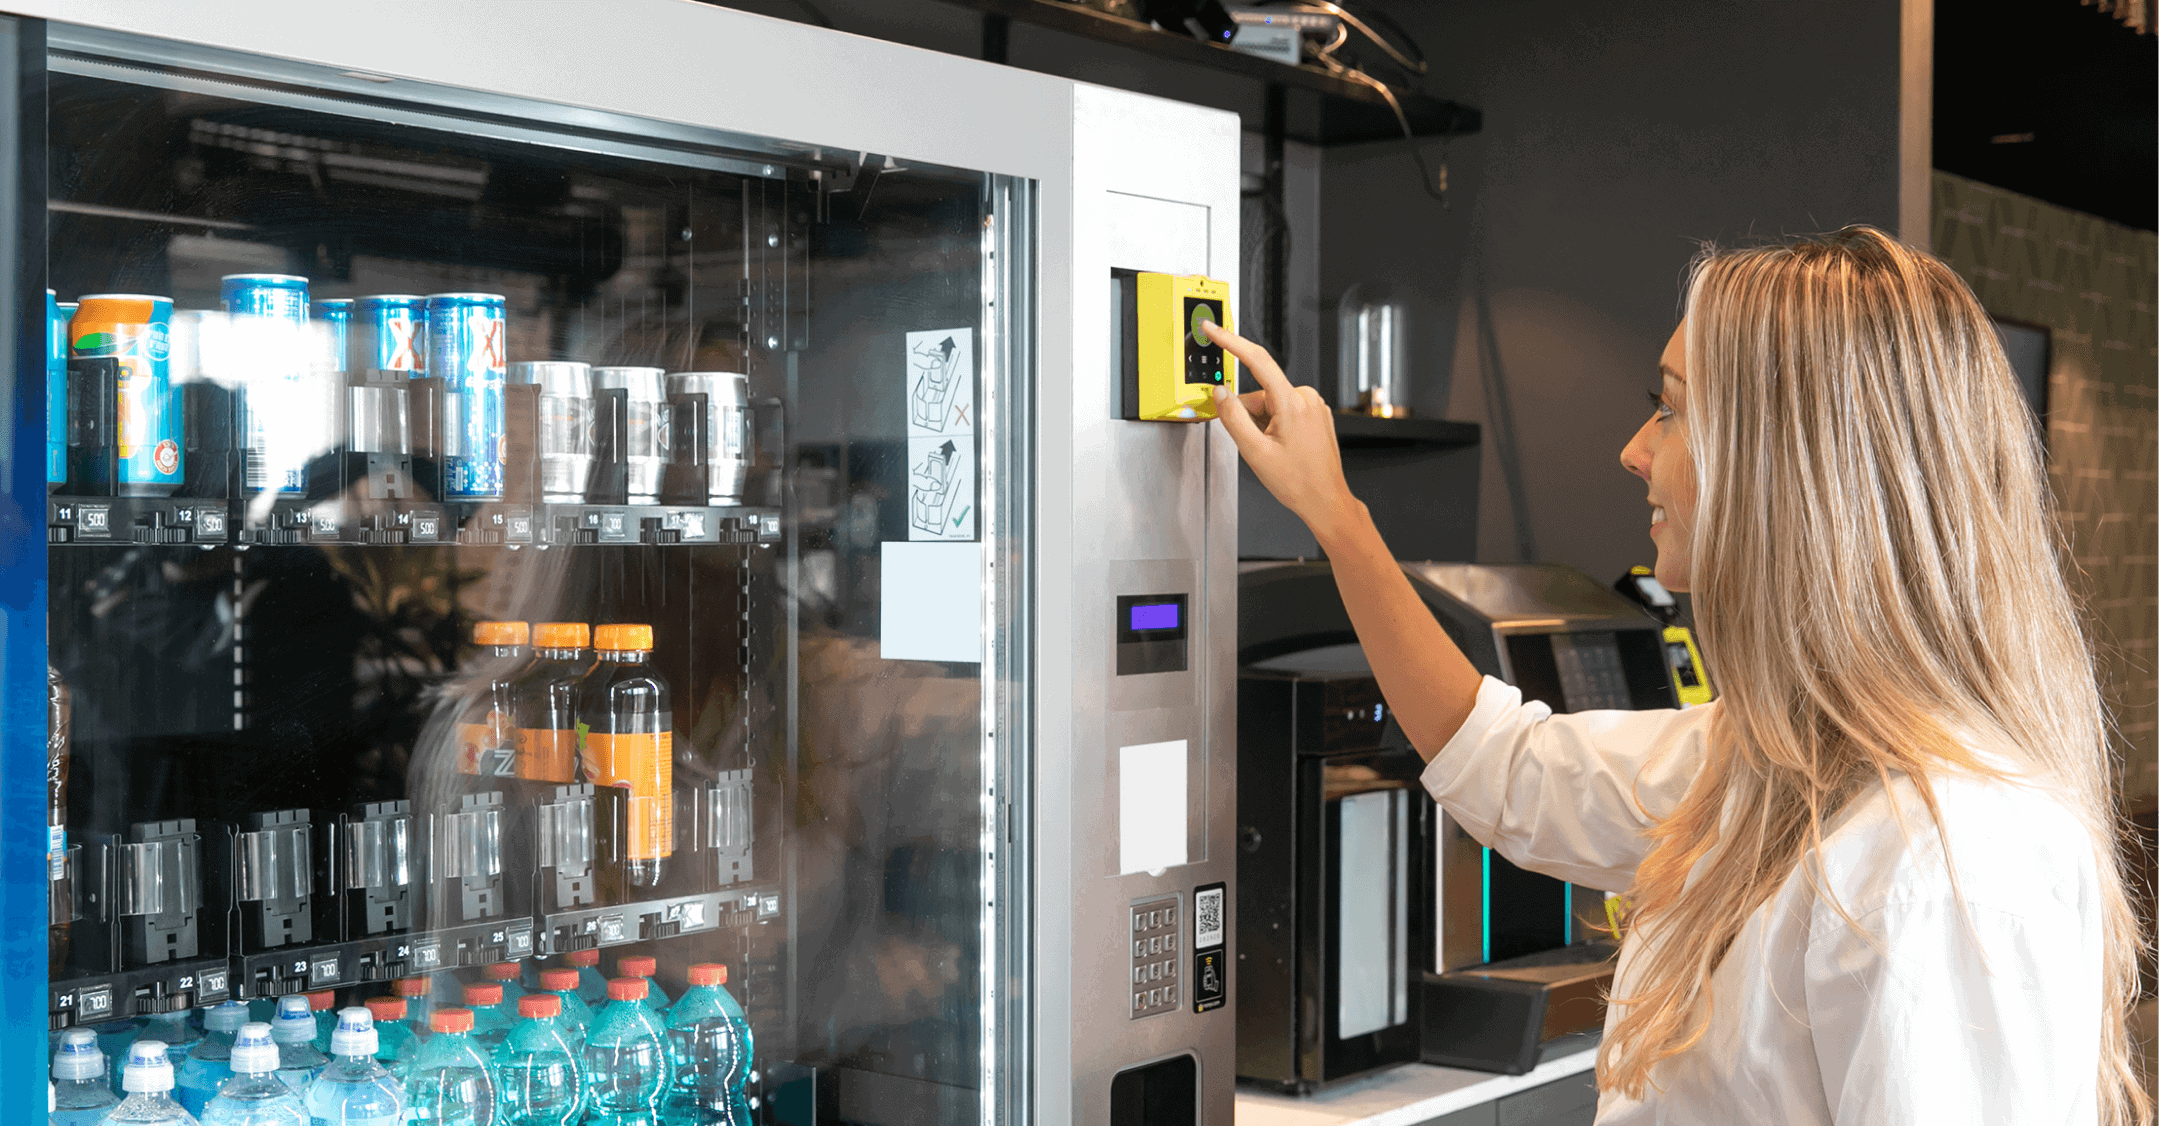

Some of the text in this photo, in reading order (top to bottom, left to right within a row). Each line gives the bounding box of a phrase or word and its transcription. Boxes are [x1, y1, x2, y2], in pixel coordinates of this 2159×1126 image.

[58, 508, 71, 520] 11
[87, 512, 106, 527] 500
[178, 510, 192, 522] 12
[295, 512, 307, 524] 13
[397, 513, 409, 525] 14
[492, 514, 503, 525] 15
[588, 514, 599, 525] 16
[748, 514, 758, 525] 18
[206, 518, 223, 532] 500
[419, 522, 435, 535] 500
[492, 931, 504, 943] 25
[397, 945, 410, 957] 24
[294, 960, 307, 973] 23
[320, 963, 336, 978] 700
[178, 976, 193, 990] 22
[207, 976, 225, 991] 700
[59, 994, 73, 1008] 21
[90, 995, 107, 1010] 700
